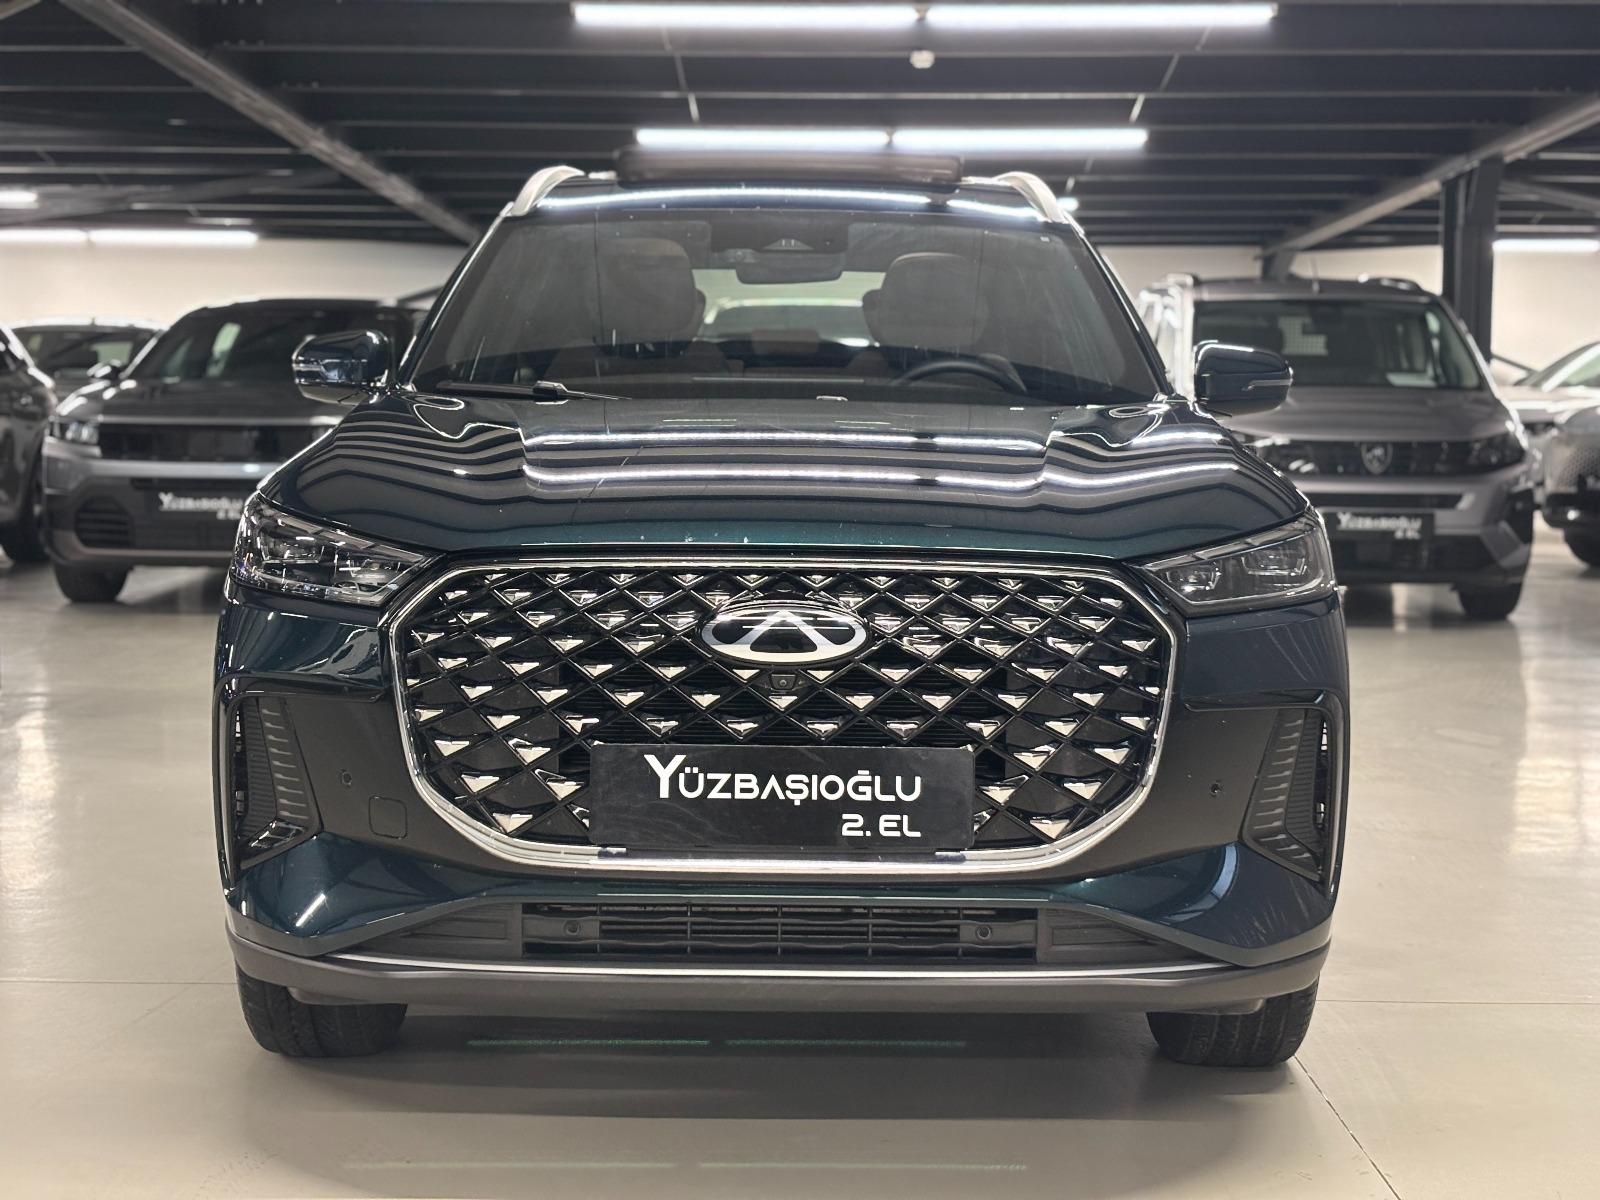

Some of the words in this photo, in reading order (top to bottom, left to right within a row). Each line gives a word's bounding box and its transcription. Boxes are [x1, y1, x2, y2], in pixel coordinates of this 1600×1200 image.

[643, 754, 922, 806] YÜZBAŞIOĞLU
[841, 813, 872, 837] 2.
[878, 814, 922, 838] EL
